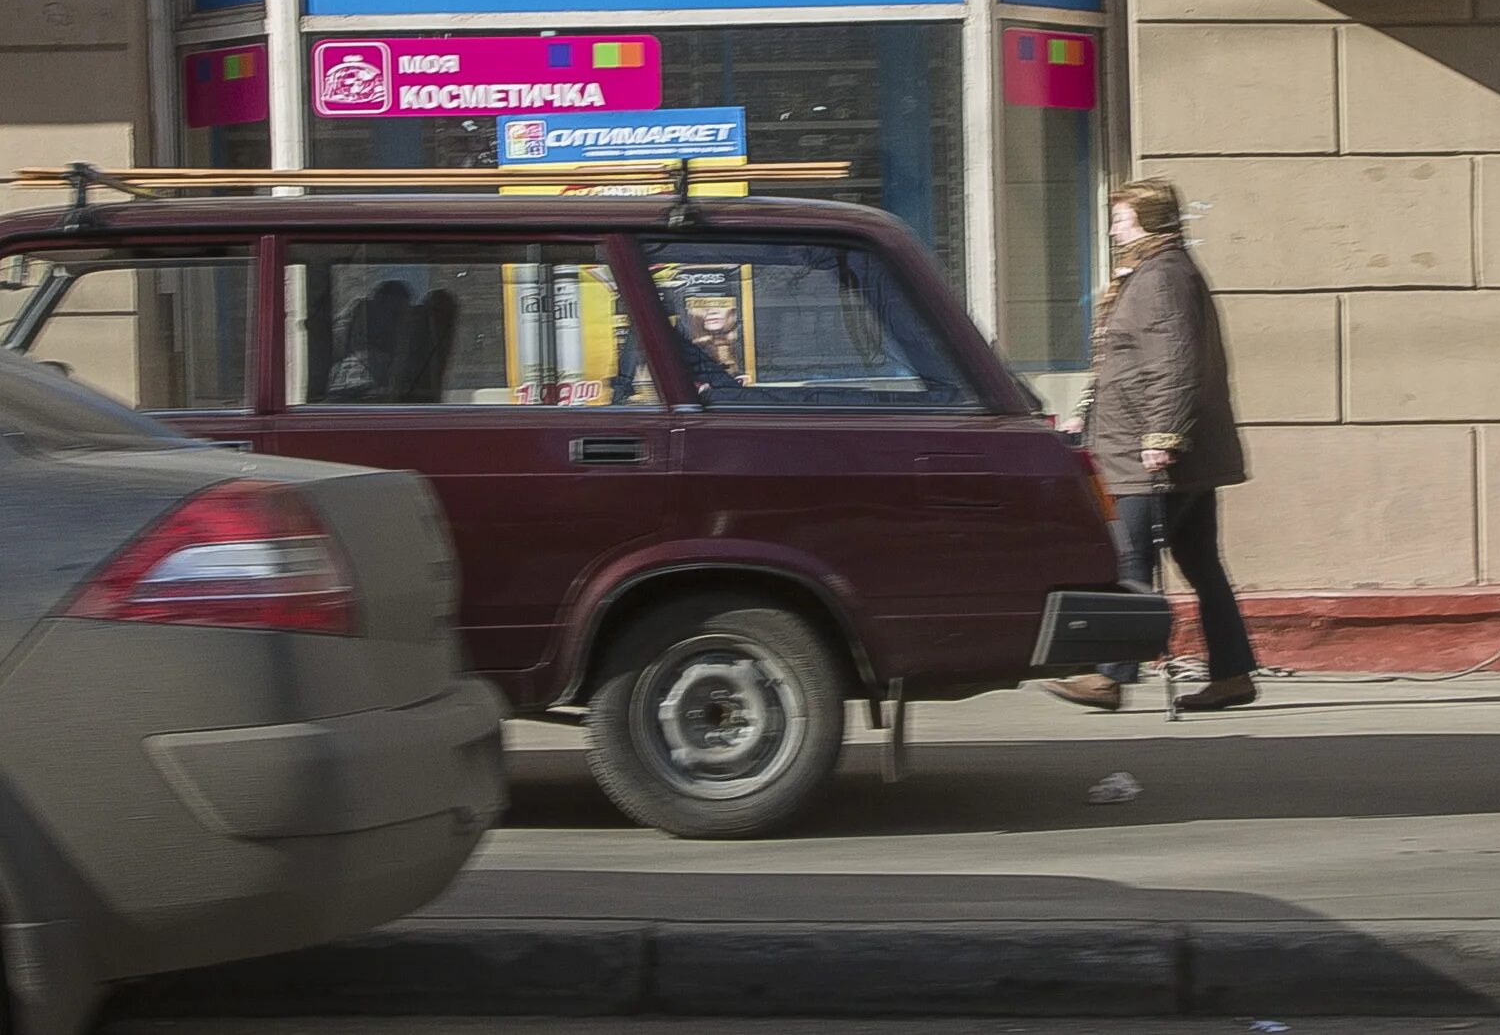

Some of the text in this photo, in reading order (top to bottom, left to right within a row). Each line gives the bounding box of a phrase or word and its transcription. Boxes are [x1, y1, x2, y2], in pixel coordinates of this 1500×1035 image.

[398, 54, 460, 74] МОЯ
[398, 82, 606, 110] КОСМЕТИЧКА
[546, 123, 738, 148] СИТИМАРКЕТ
